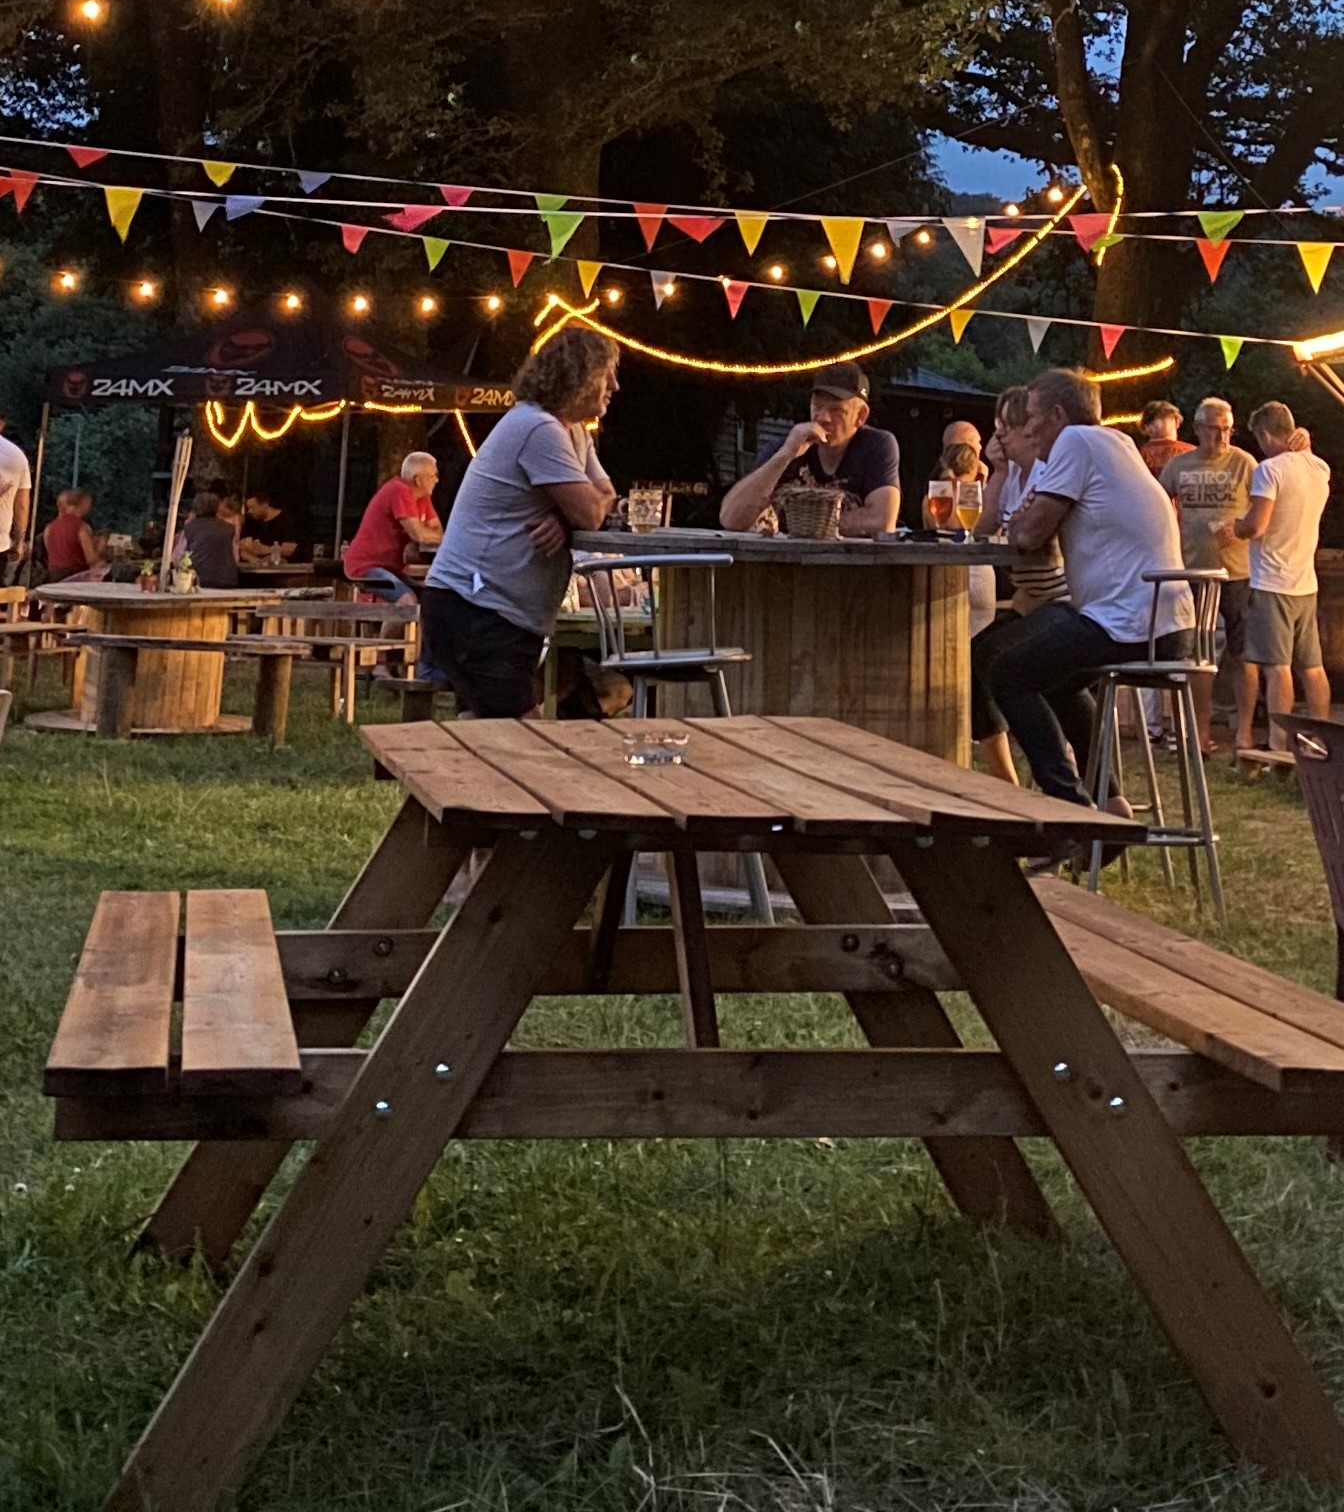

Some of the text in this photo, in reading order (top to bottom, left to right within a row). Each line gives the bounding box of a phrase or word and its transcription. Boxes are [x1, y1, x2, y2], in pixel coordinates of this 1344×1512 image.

[91, 378, 175, 397] 24MX
[234, 377, 323, 396] 24MX
[380, 384, 436, 402] 24MX
[469, 387, 515, 407] 24M
